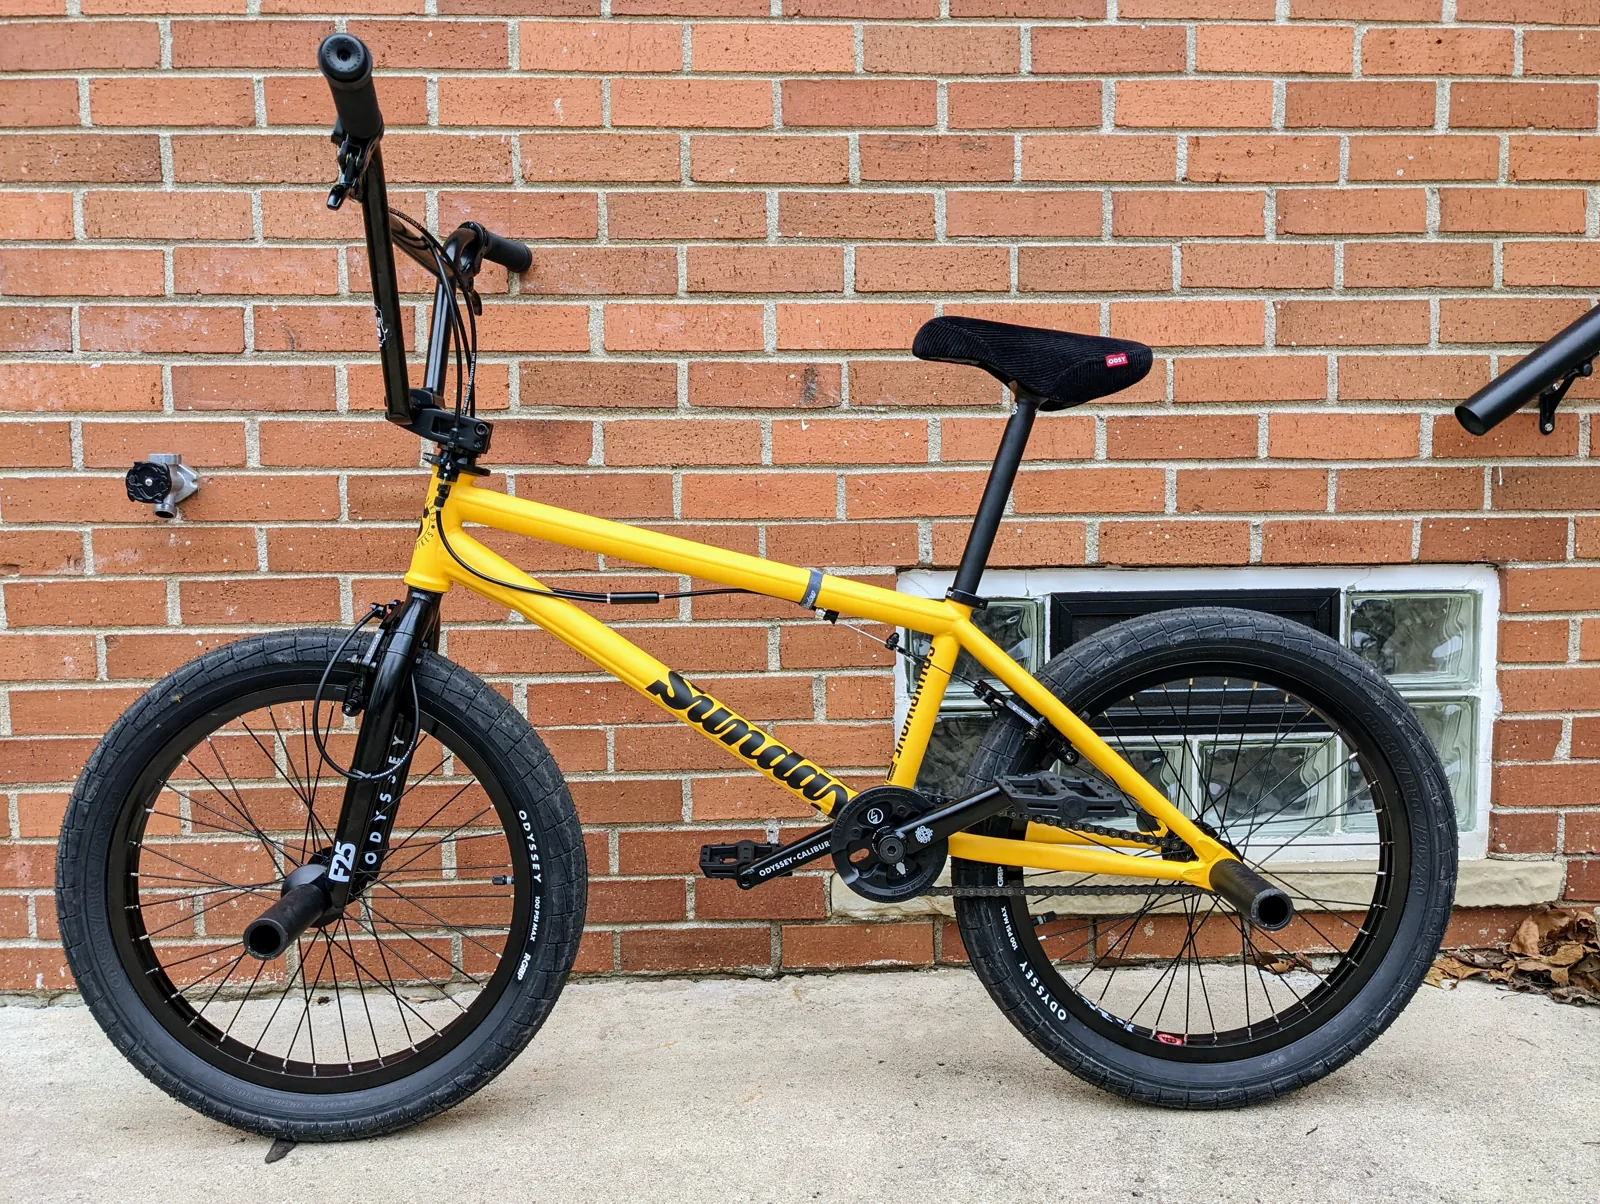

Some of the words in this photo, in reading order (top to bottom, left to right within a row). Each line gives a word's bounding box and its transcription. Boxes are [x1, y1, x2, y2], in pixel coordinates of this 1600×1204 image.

[518, 810, 542, 883] ODYSSEY
[328, 840, 356, 882] F25
[1000, 906, 1009, 925] MAX
[529, 923, 539, 942] MAX
[1005, 924, 1013, 938] PSI
[1010, 937, 1019, 951] 100
[1018, 961, 1067, 1021] ODYSSEY
